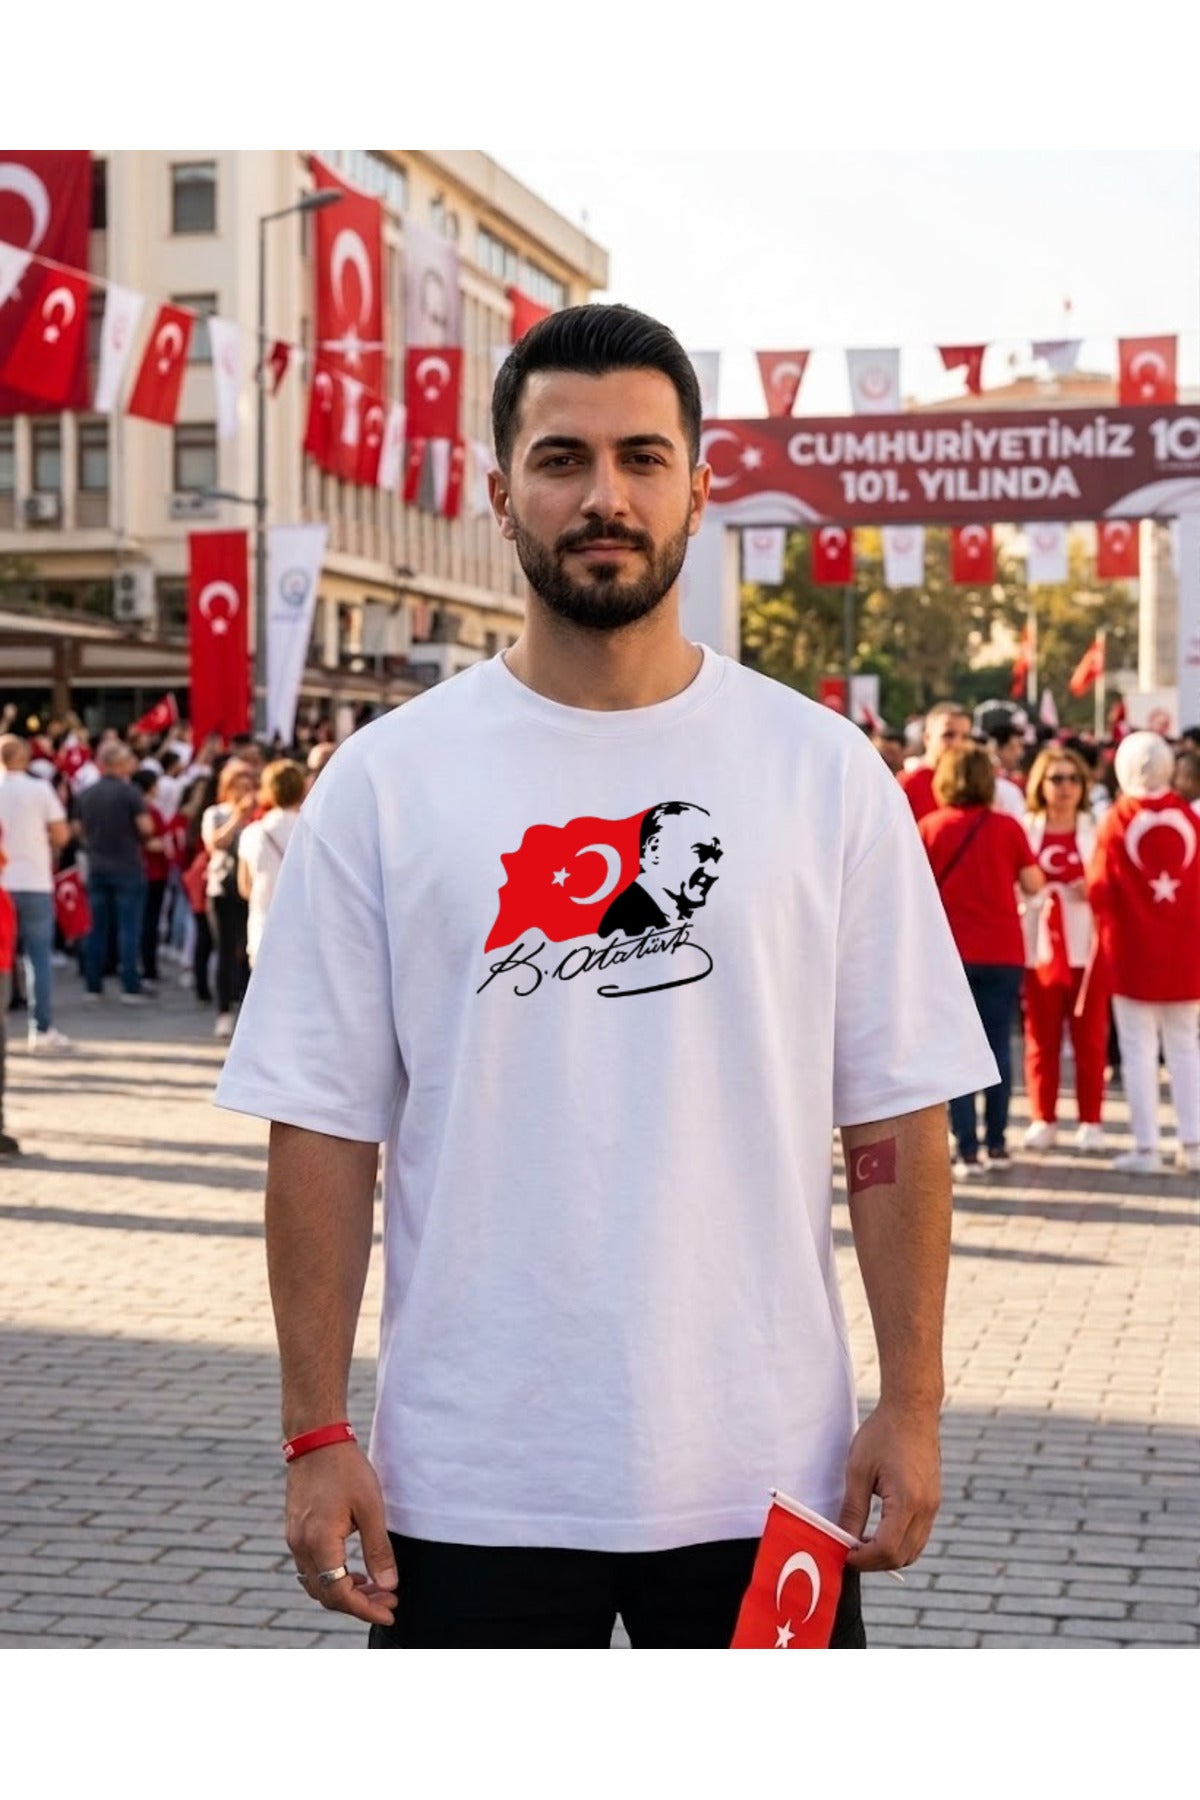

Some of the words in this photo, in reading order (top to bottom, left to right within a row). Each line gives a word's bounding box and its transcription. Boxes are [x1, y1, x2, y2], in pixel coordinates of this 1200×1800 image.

[788, 416, 1135, 466] CUMHURİYETİMİZ
[841, 470, 909, 503] 101.
[919, 467, 1080, 502] YILINDA
